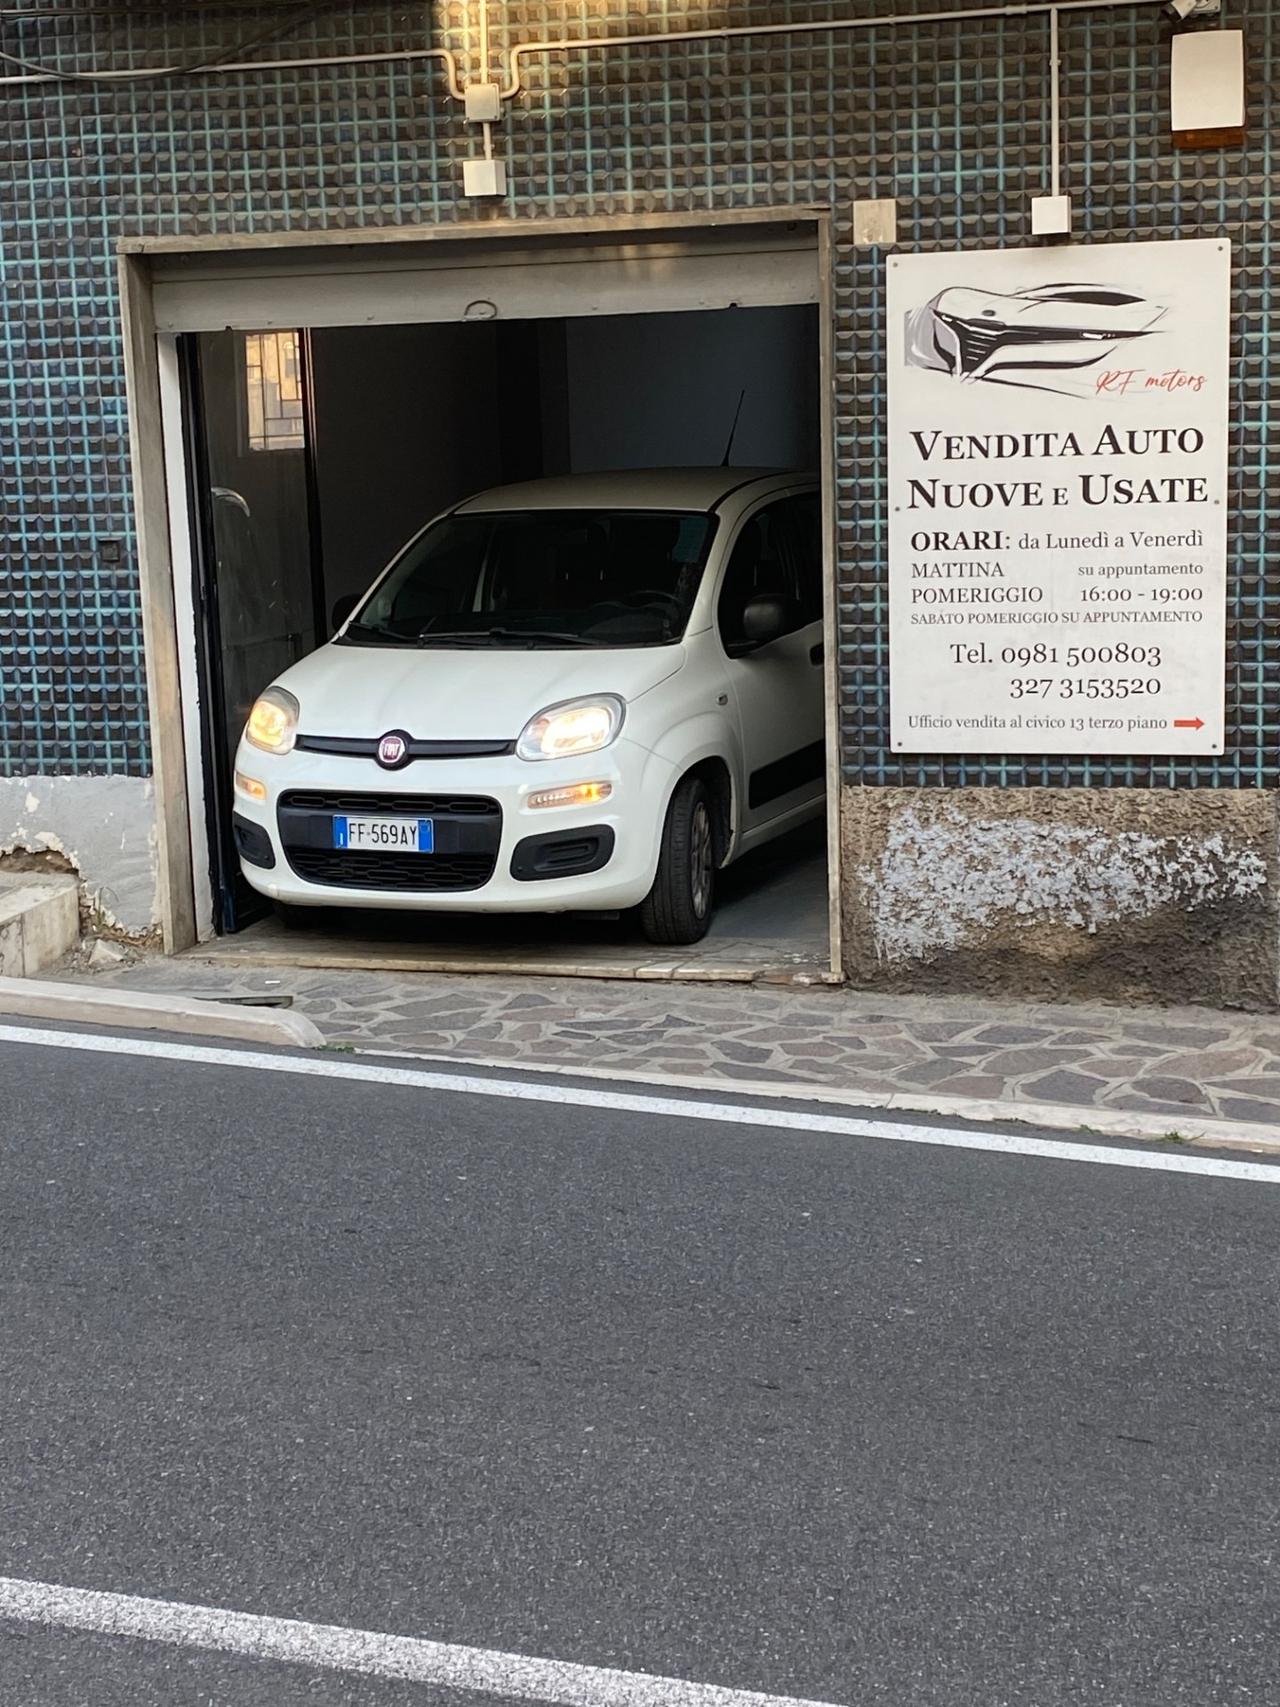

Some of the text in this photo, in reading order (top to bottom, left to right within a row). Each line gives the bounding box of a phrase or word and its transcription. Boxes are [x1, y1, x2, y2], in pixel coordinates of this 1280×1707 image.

[1096, 368, 1206, 395] RF motors
[909, 424, 1204, 461] VENDITA AUTO
[906, 473, 1209, 509] NUOVE E USATE
[910, 529, 1203, 552] ORARI: da Lunedì a Venerdì
[911, 561, 1204, 579] MATTINA su appuntamento
[911, 586, 1043, 604] POMERIGGIO
[1080, 587, 1132, 602] 16:00
[1151, 588, 1203, 604] 19:00
[910, 610, 1203, 625] SABATO POMERIGGIO SU APPUNTAMENTO
[950, 642, 1162, 668] Tel. 0981 500803
[1009, 678, 1161, 699] 327 3153520
[908, 714, 1168, 733] Ufficio vendita al civico 13 terzo piano
